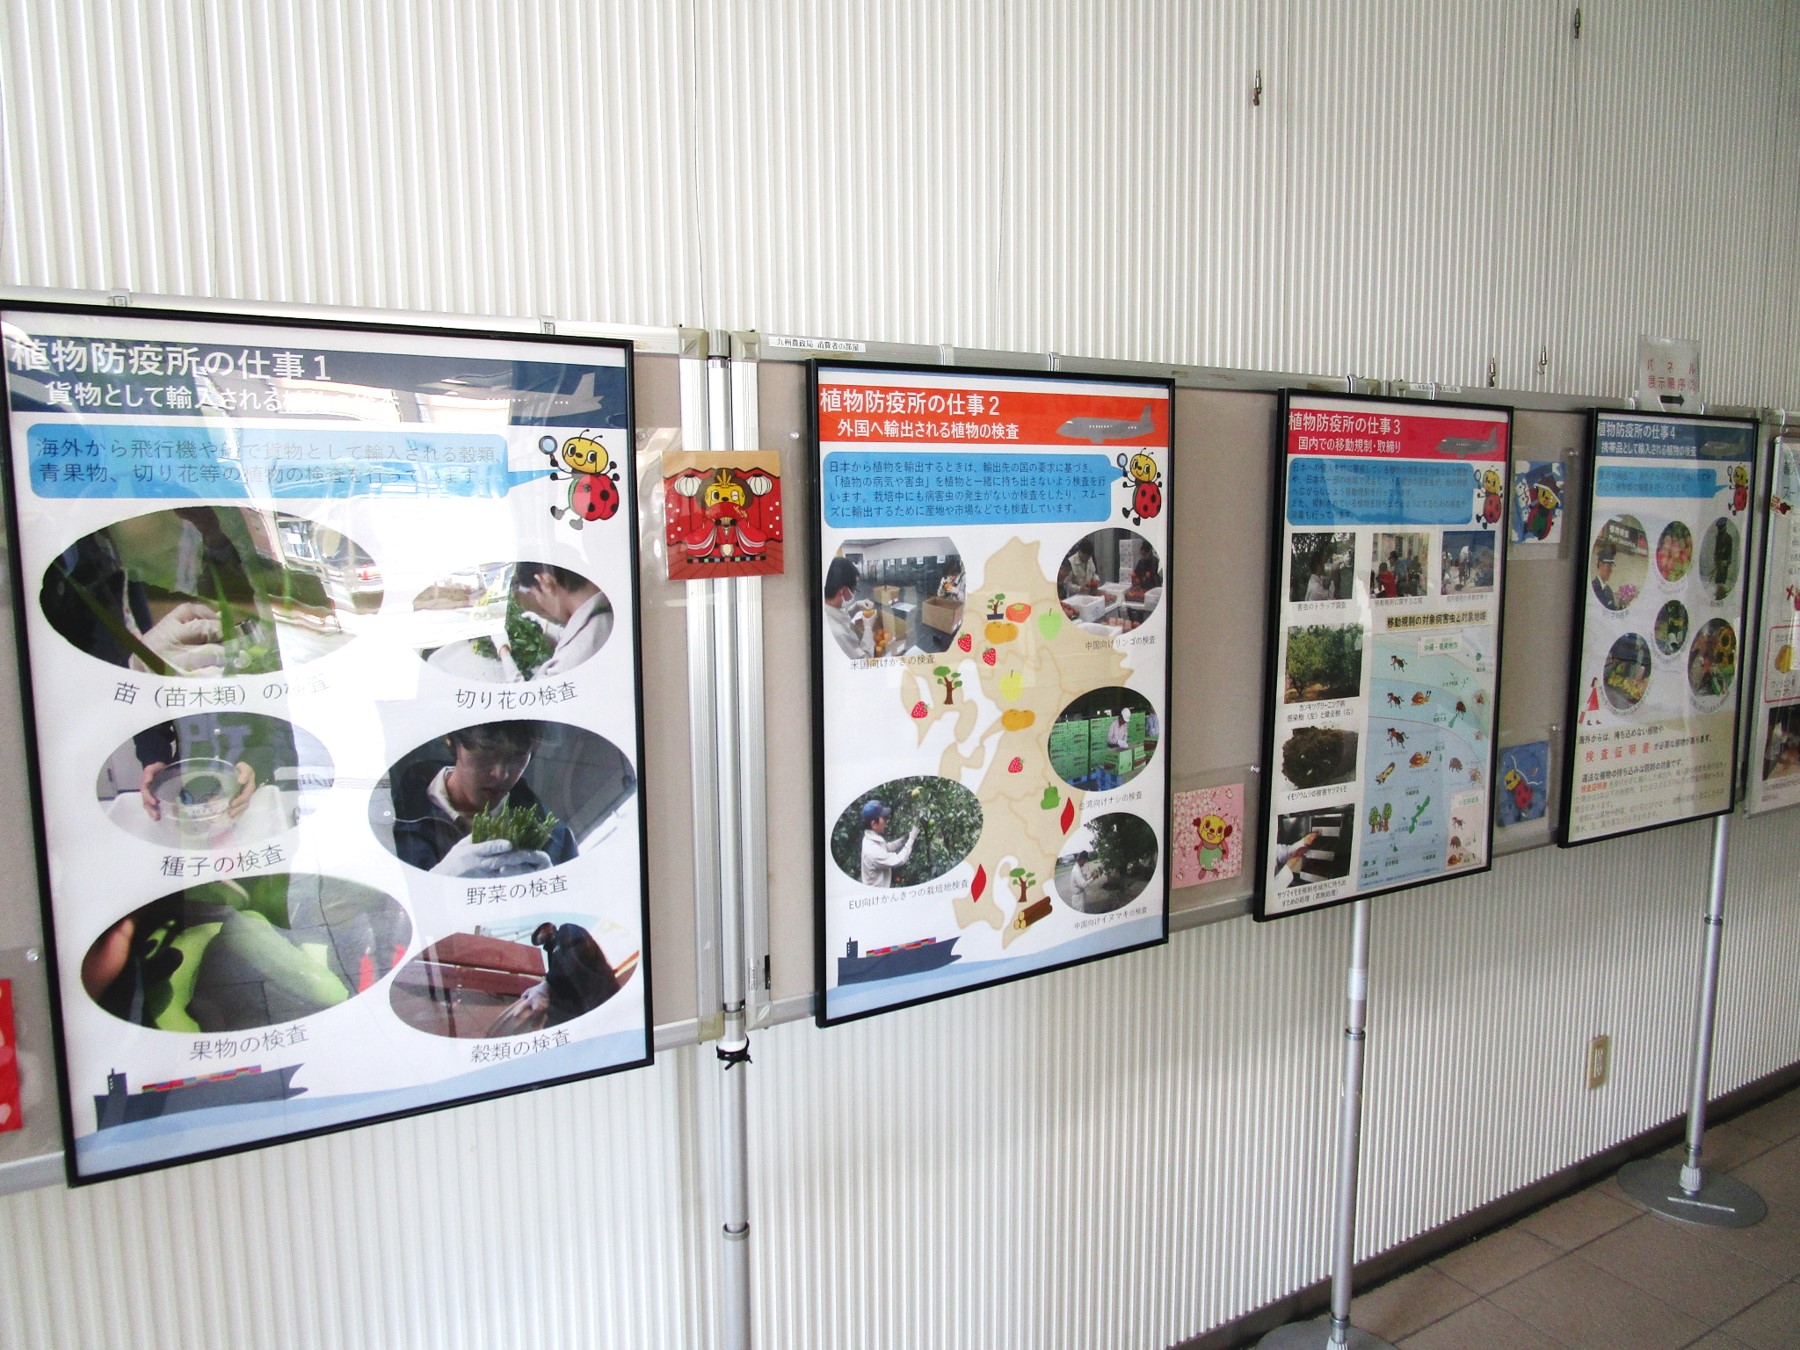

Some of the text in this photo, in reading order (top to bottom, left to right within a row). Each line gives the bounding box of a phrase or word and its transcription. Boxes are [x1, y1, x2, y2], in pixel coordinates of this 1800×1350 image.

[11, 338, 331, 381] 植物防疫所の仕事1
[46, 381, 400, 414] 貨物として輸入される
[819, 387, 1000, 416] 植物防疫所の仕事2
[837, 418, 1020, 440] 外国へ輸出される植物の検査
[1288, 411, 1401, 435] 植物防疫所の仕事3
[1085, 635, 1157, 651] 中国向けリンゴの検査
[850, 654, 936, 670] 米国向けかきの検査
[455, 681, 579, 711] 切り花の検査
[1078, 790, 1143, 811] 台湾向けナシの検査
[160, 844, 287, 879] 種子の検査
[465, 874, 569, 906] 野菜の検査
[848, 878, 969, 910] EU向けかんきつの栽培地検査
[189, 1024, 310, 1062] 果物の検査
[470, 1029, 573, 1065] 穀類の検査
